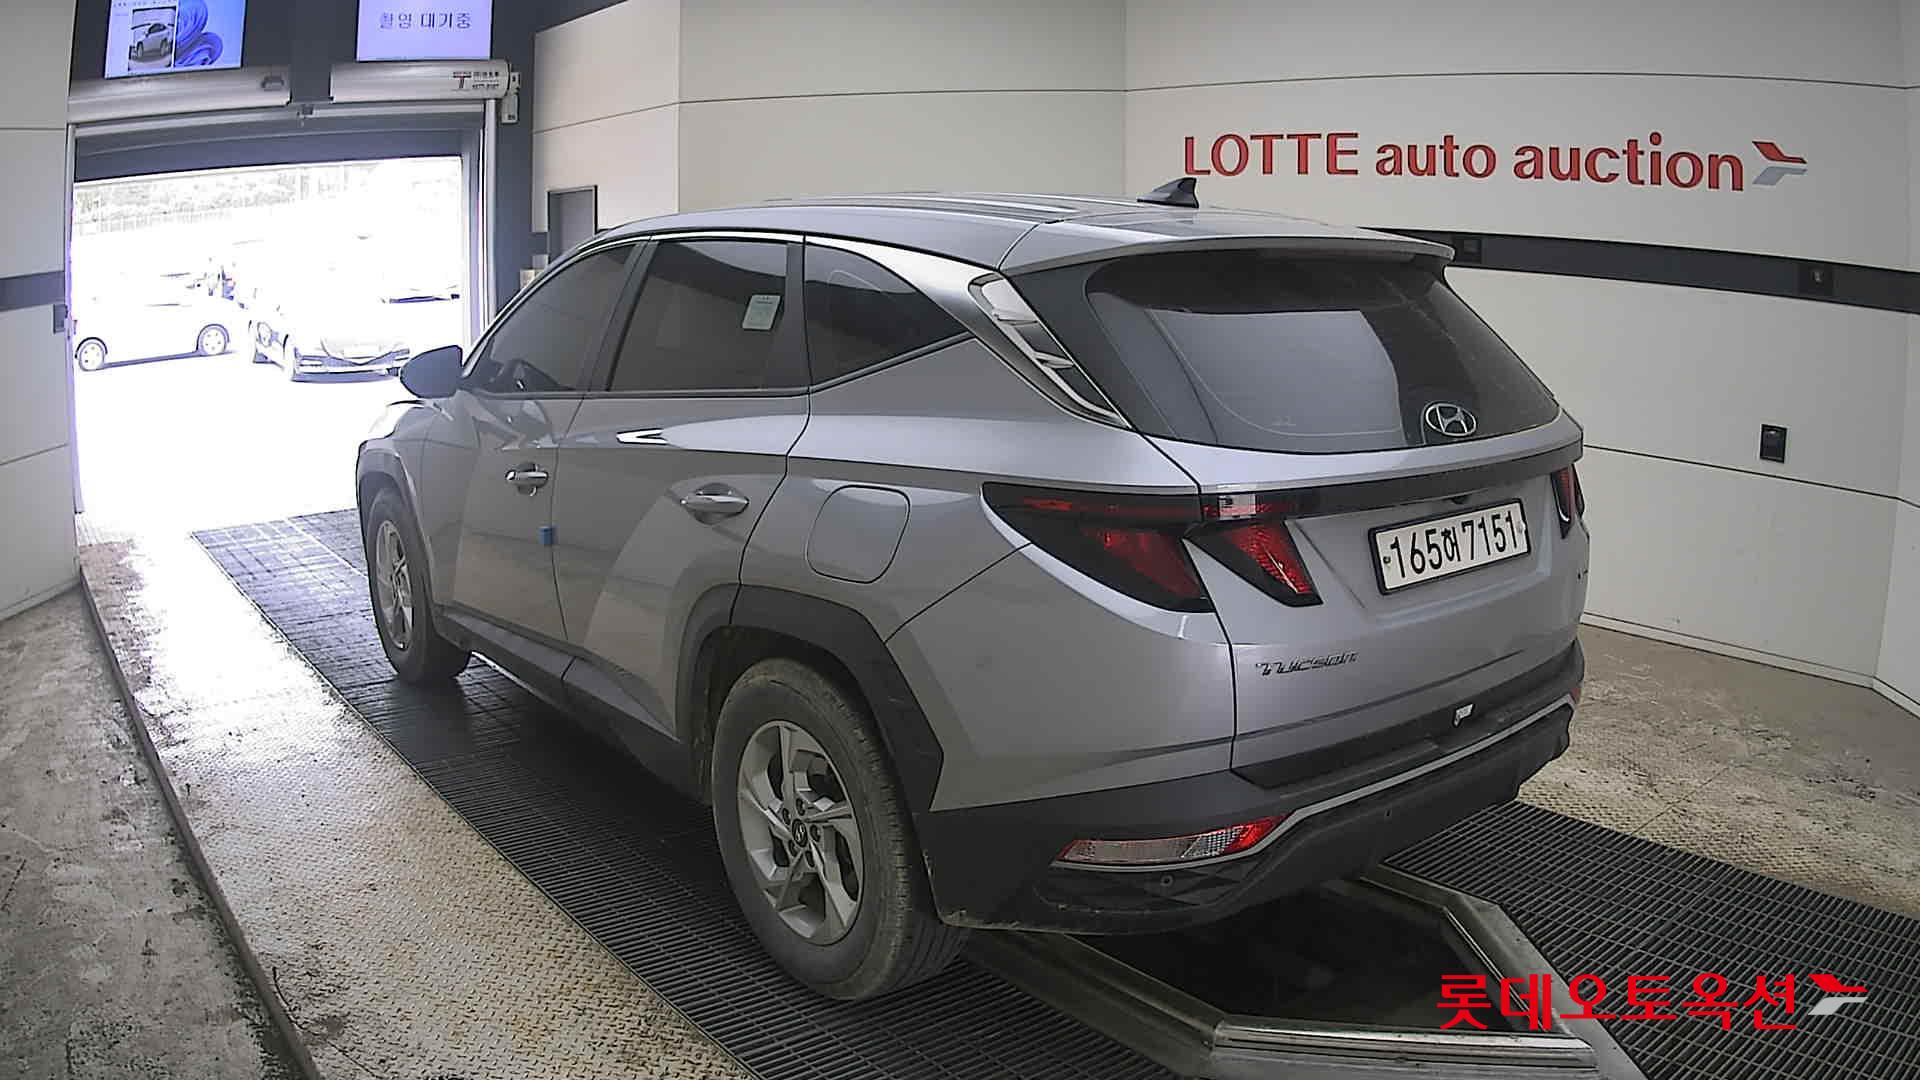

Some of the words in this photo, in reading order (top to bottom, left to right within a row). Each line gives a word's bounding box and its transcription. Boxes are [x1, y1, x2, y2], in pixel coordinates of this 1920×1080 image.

[421, 12, 471, 29] 대기중
[1184, 132, 1359, 176] LOTTE
[1375, 134, 1498, 178] auto
[1512, 131, 1745, 192] auction
